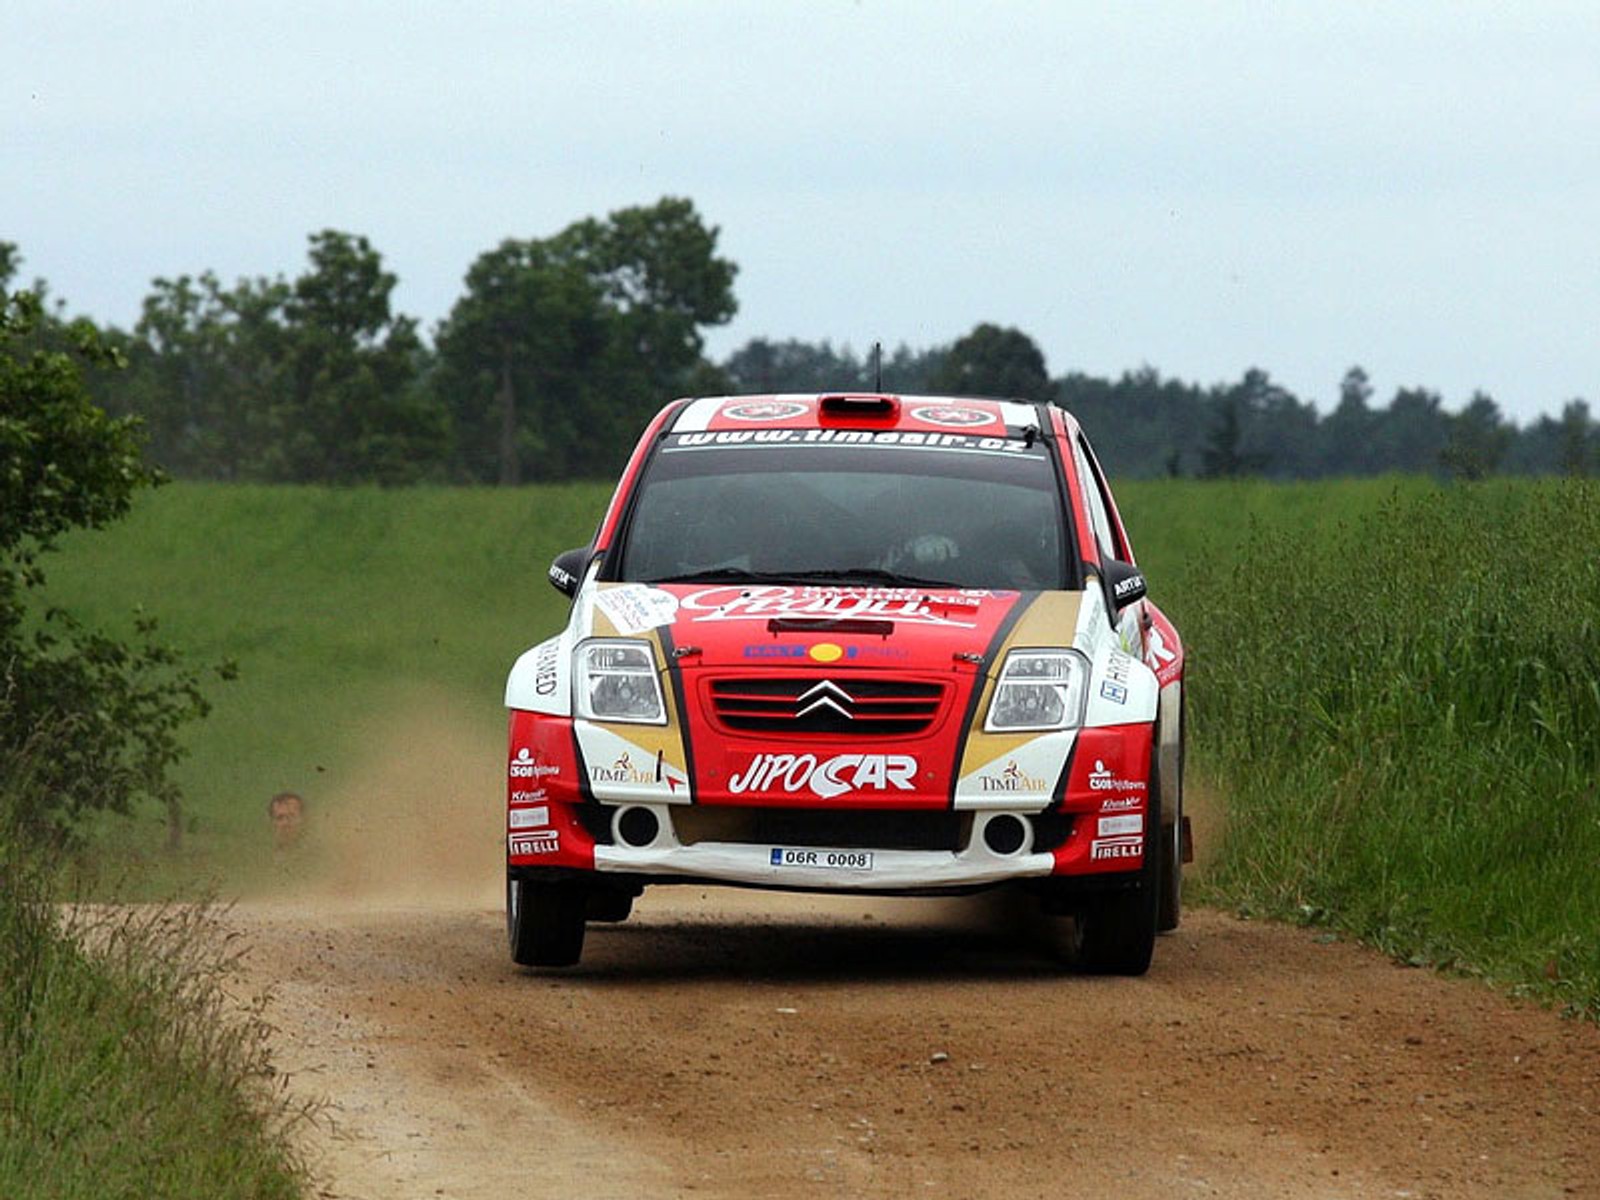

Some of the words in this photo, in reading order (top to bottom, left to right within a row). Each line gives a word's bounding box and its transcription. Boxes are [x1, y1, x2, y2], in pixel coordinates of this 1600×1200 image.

[677, 429, 1026, 453] www.timeair.cz
[509, 830, 560, 856] PIRELLI
[1091, 836, 1143, 860] PIRELLI
[785, 851, 818, 865] 06R
[827, 853, 866, 867] 0008
